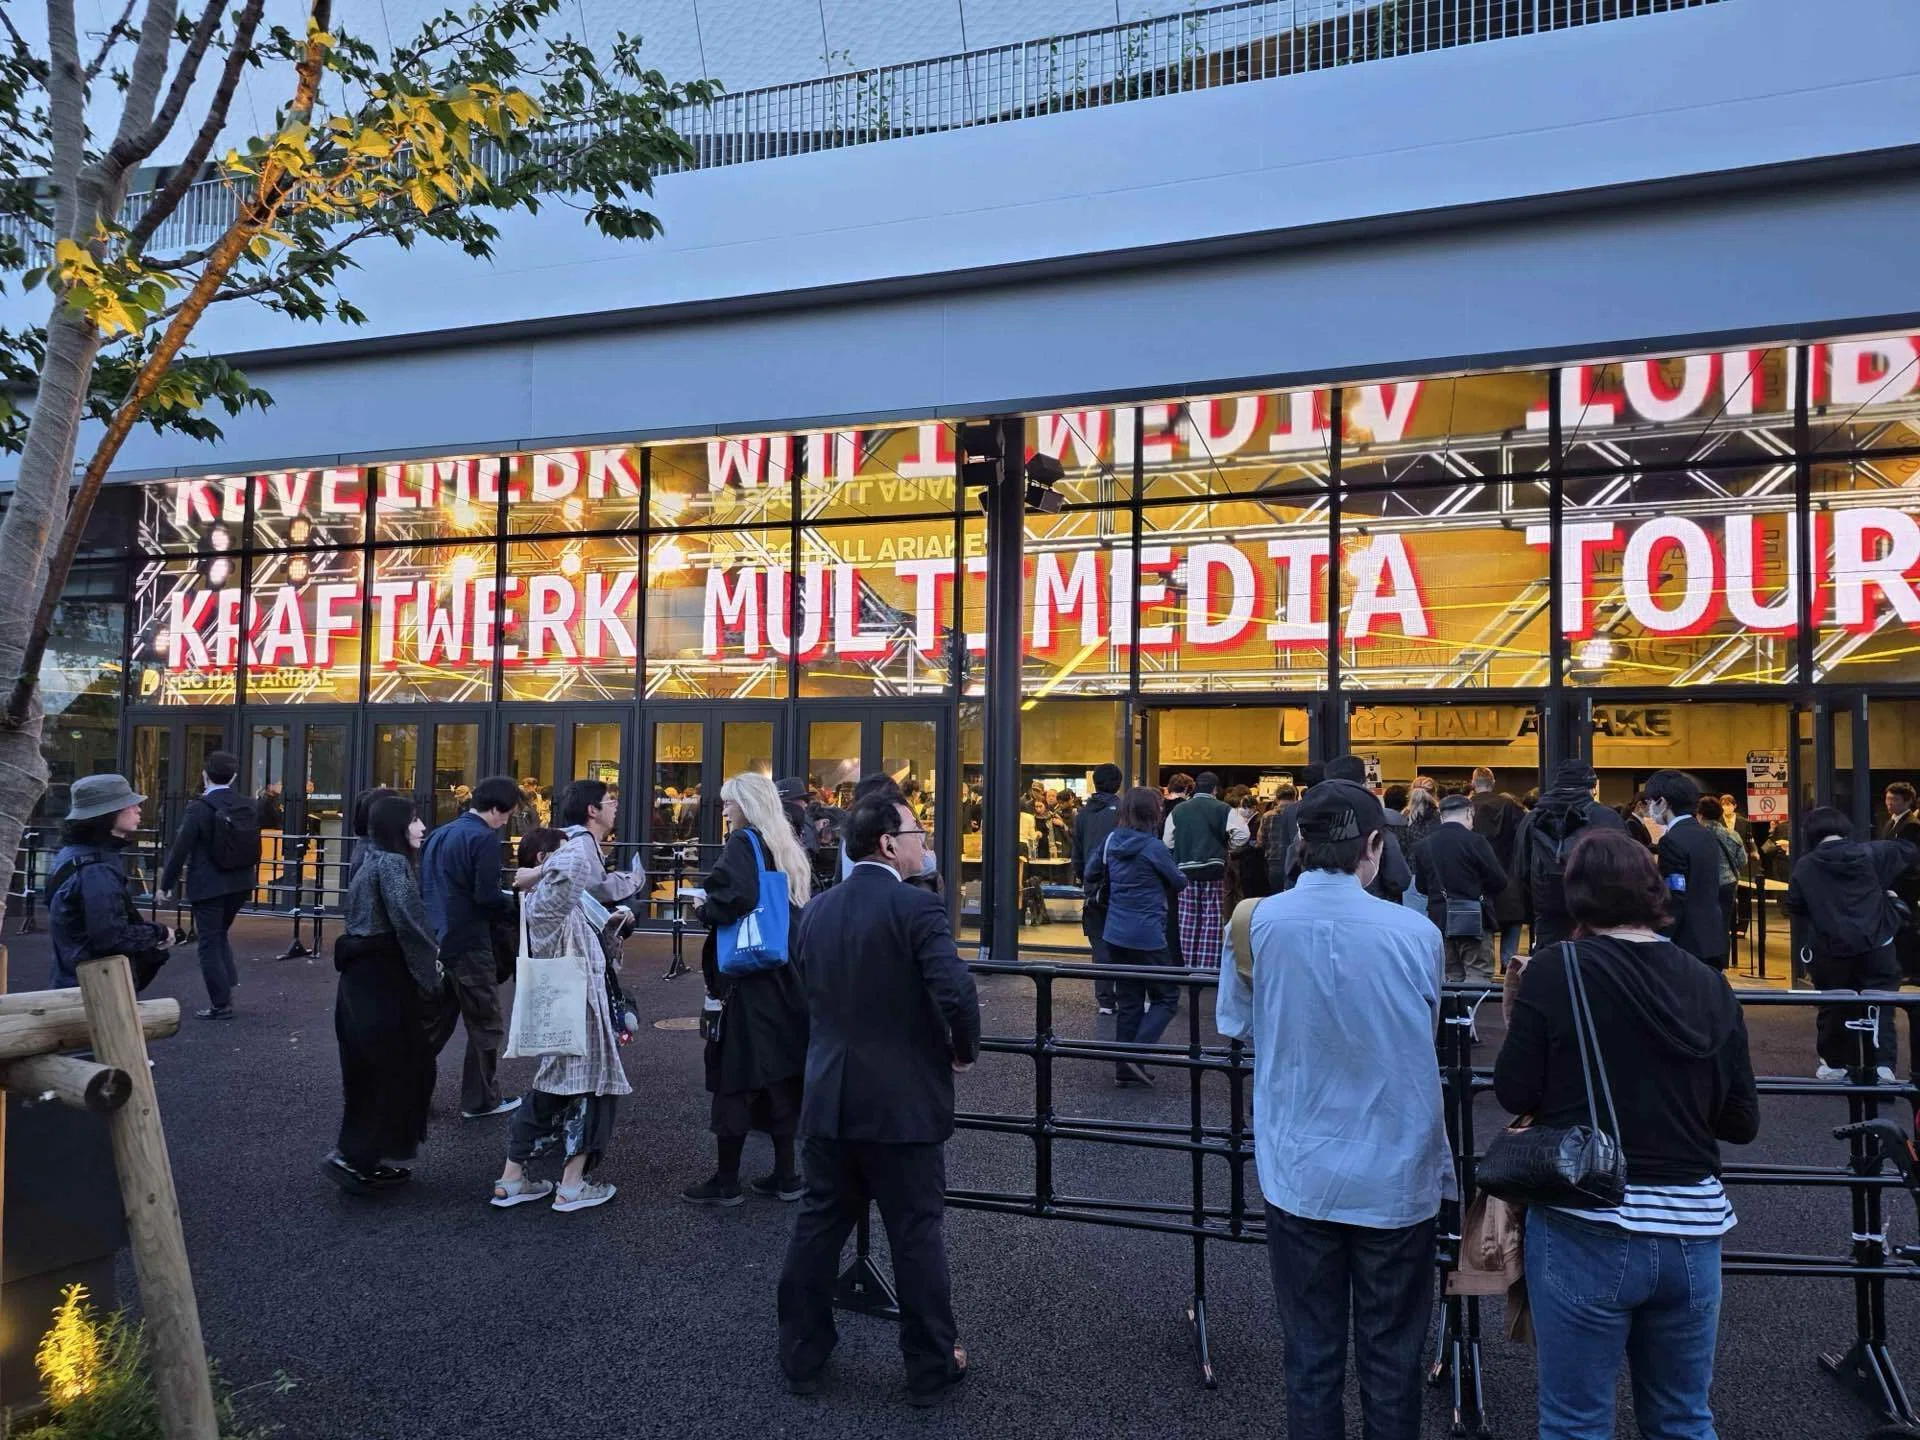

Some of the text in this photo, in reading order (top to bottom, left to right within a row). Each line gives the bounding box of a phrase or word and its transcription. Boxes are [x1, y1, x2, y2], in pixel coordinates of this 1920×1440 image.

[802, 540, 872, 563] ALL
[168, 572, 638, 669] KRAFTWERK
[1526, 508, 1920, 634] TOUR
[208, 670, 257, 688] HAL
[1411, 709, 1509, 738] HALL
[1516, 709, 1672, 738] AAKE
[664, 745, 695, 759] 1R-3
[1172, 746, 1211, 760] 1R-2
